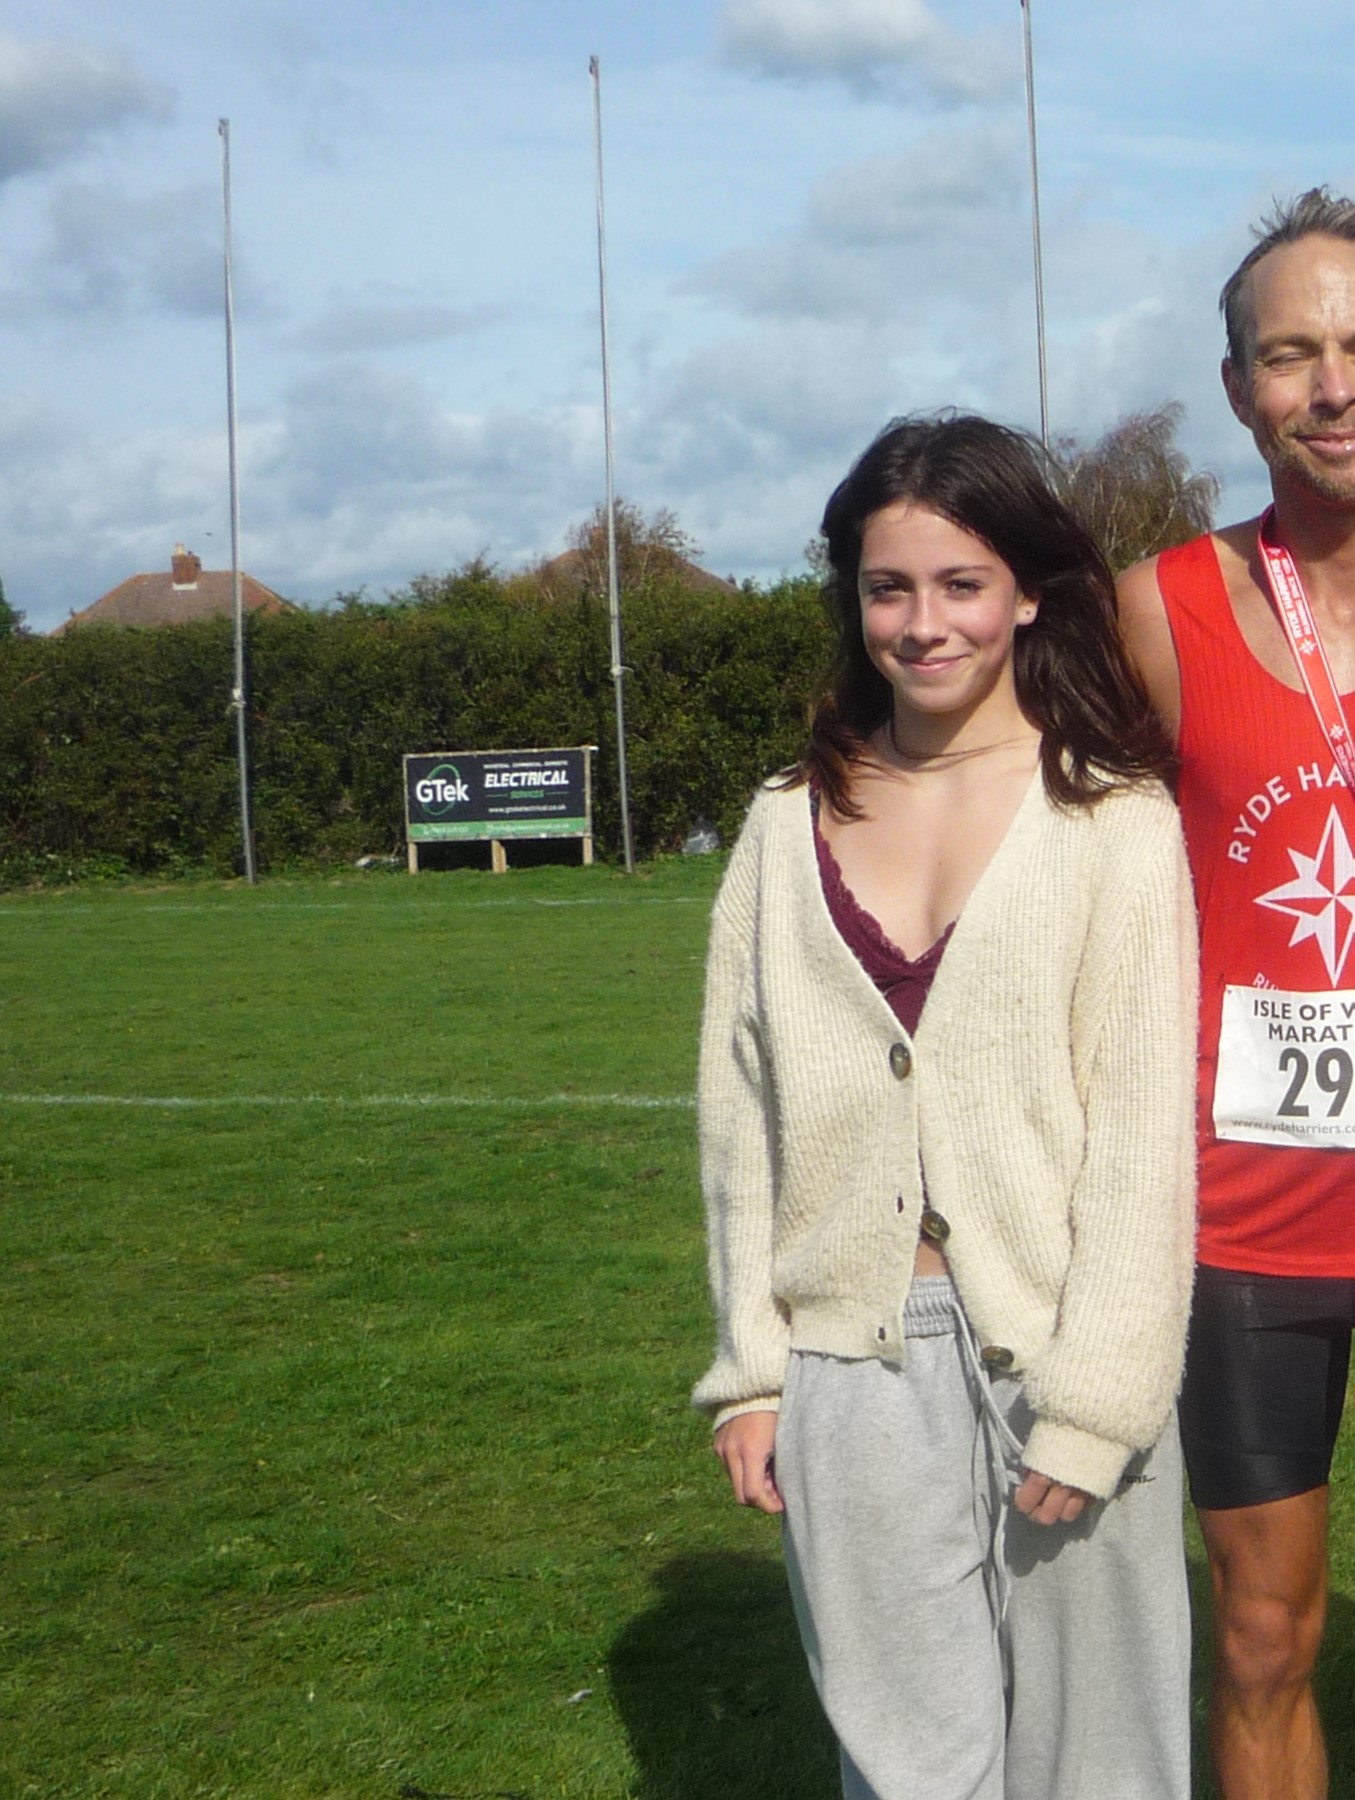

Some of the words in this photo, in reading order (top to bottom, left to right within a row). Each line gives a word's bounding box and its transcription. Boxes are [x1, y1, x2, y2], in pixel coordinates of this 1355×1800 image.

[484, 770, 569, 788] ELECTRICAL
[416, 779, 470, 803] GTek
[1228, 775, 1292, 864] RYDE
[1253, 999, 1292, 1020] ISLE
[1299, 1003, 1333, 1021] OF
